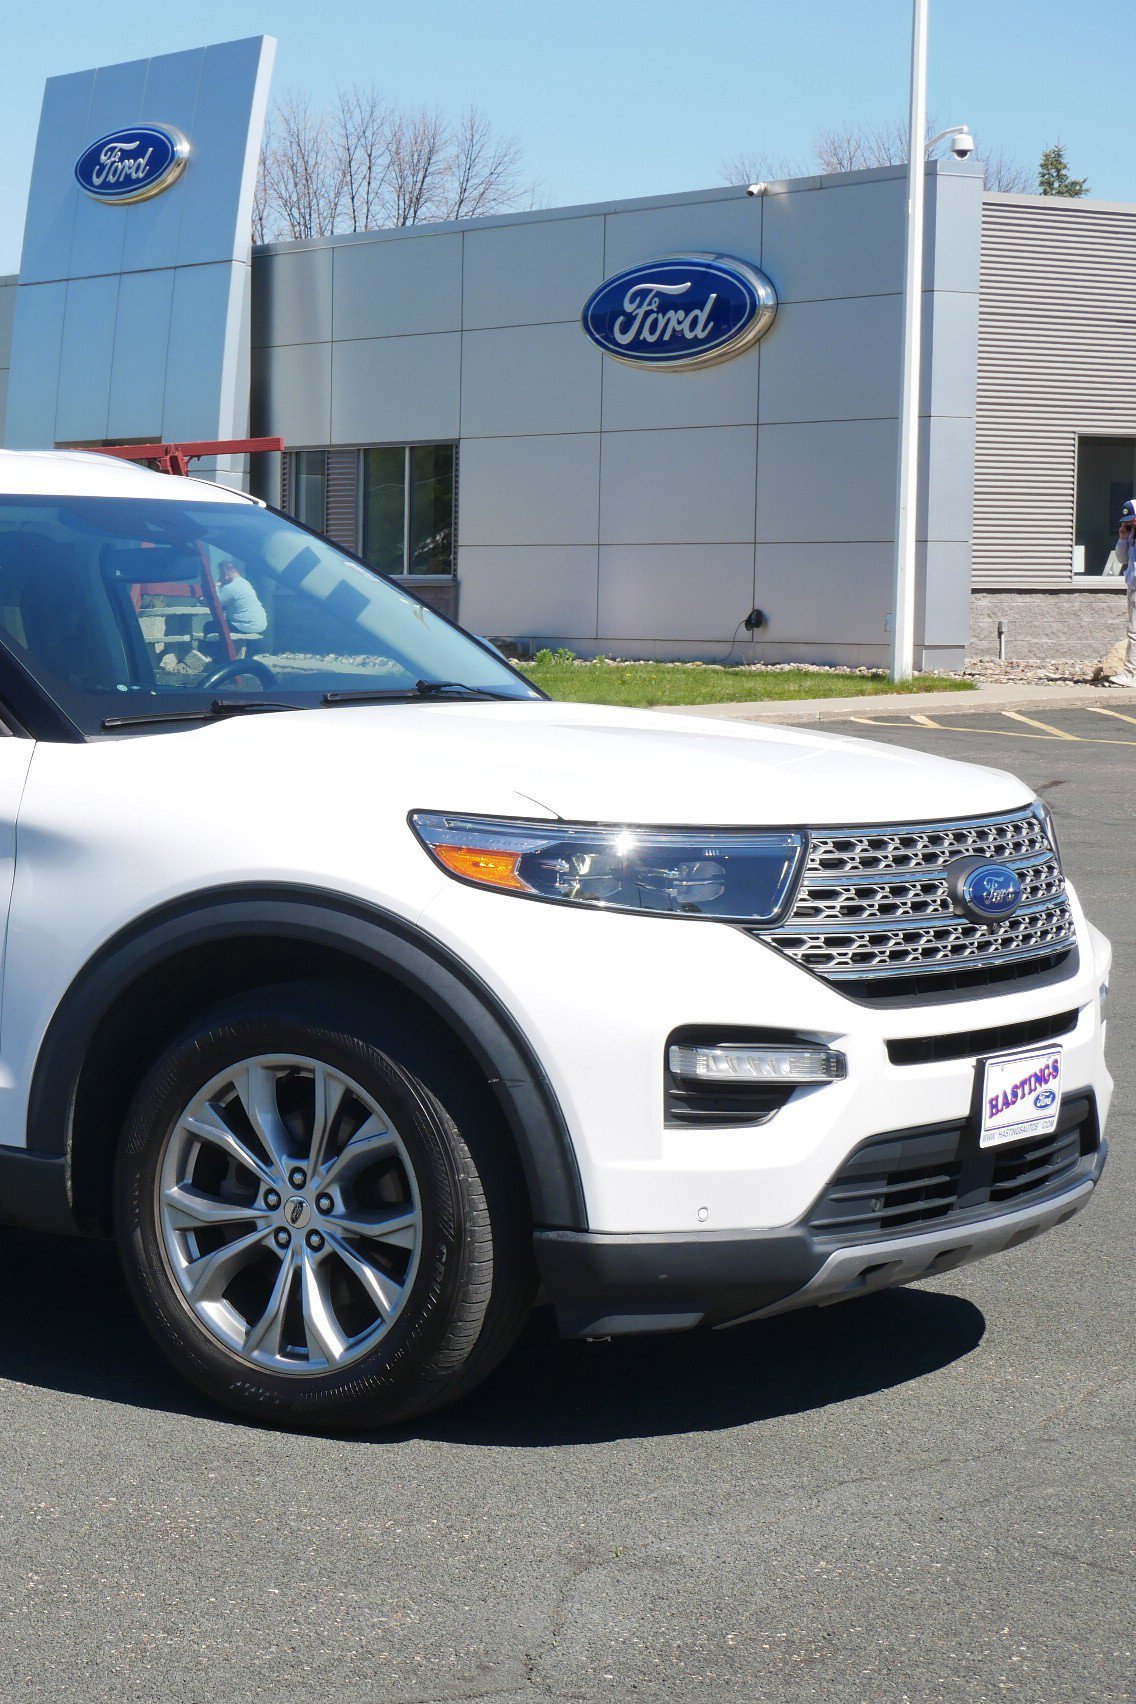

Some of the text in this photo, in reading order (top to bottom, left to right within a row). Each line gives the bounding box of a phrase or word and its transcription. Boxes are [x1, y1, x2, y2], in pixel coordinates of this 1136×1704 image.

[92, 140, 154, 186] Ford
[614, 282, 718, 345] Ford
[983, 876, 1017, 904] Ford
[988, 1058, 1059, 1119] HASTINGS
